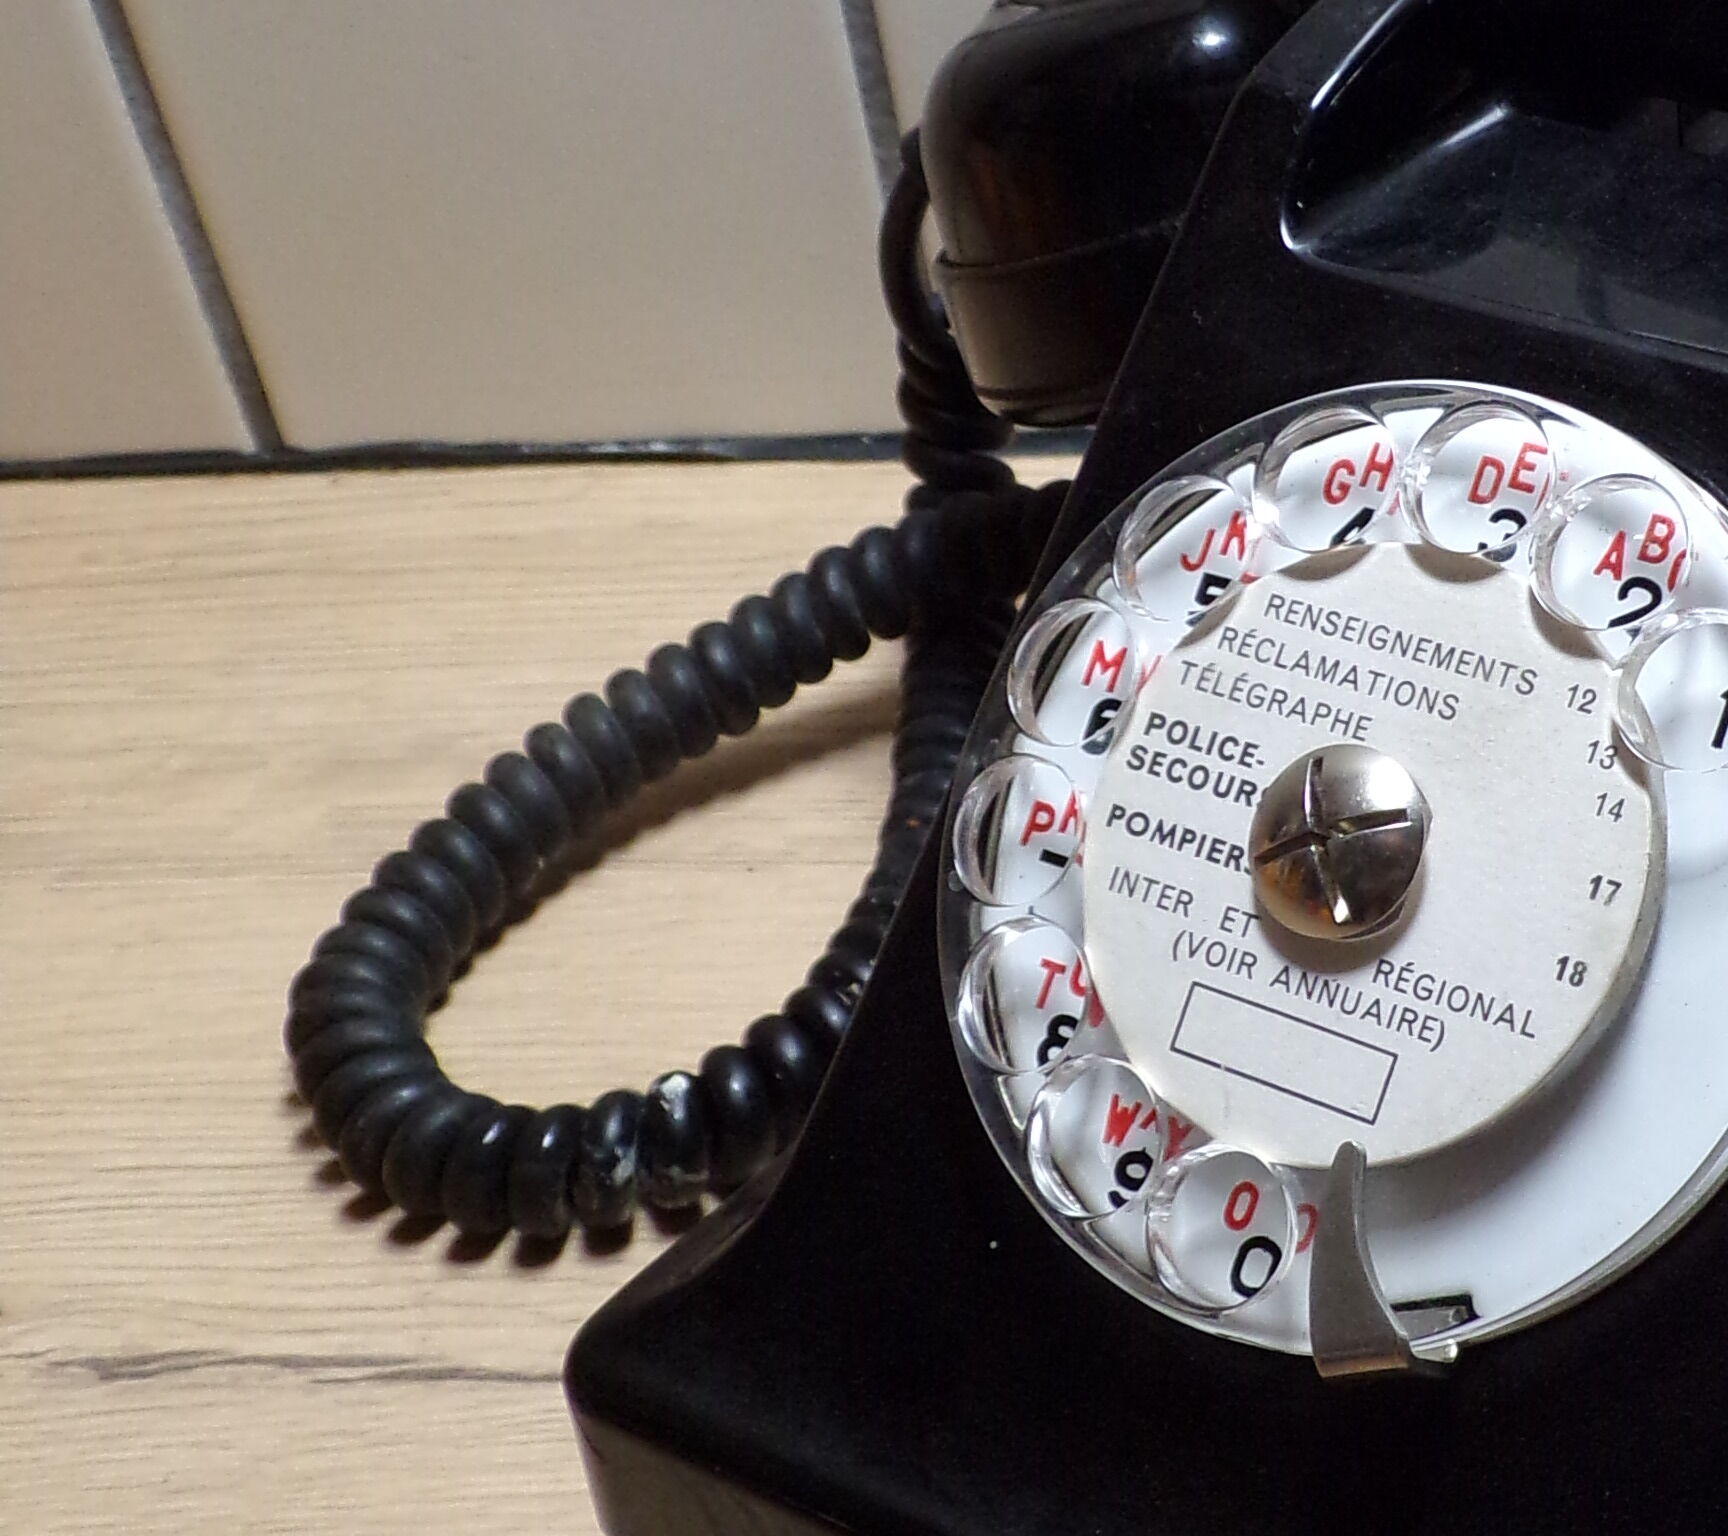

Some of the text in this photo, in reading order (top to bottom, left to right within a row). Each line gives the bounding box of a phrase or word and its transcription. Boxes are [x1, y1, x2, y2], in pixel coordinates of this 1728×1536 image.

[1478, 508, 1527, 562] 3
[1264, 592, 1597, 715] RENSEIGNEMENTS 12
[1607, 576, 1662, 630] 2
[1143, 712, 1265, 768] POLICE-
[1180, 660, 1624, 824] TÉLÉGRAPHE 14
[1217, 626, 1618, 771] RÉCLAMATIONS 13
[1126, 745, 1622, 907] SECOUR 17
[1106, 804, 1588, 988] POMPIER 18
[1108, 866, 1537, 1040] INTER ET RÉGIONAL
[1037, 1014, 1078, 1066] 8
[1172, 929, 1446, 1052] (VOIR ANNUAIRE)
[1108, 1147, 1154, 1208] 9
[1230, 1236, 1282, 1298] 0
